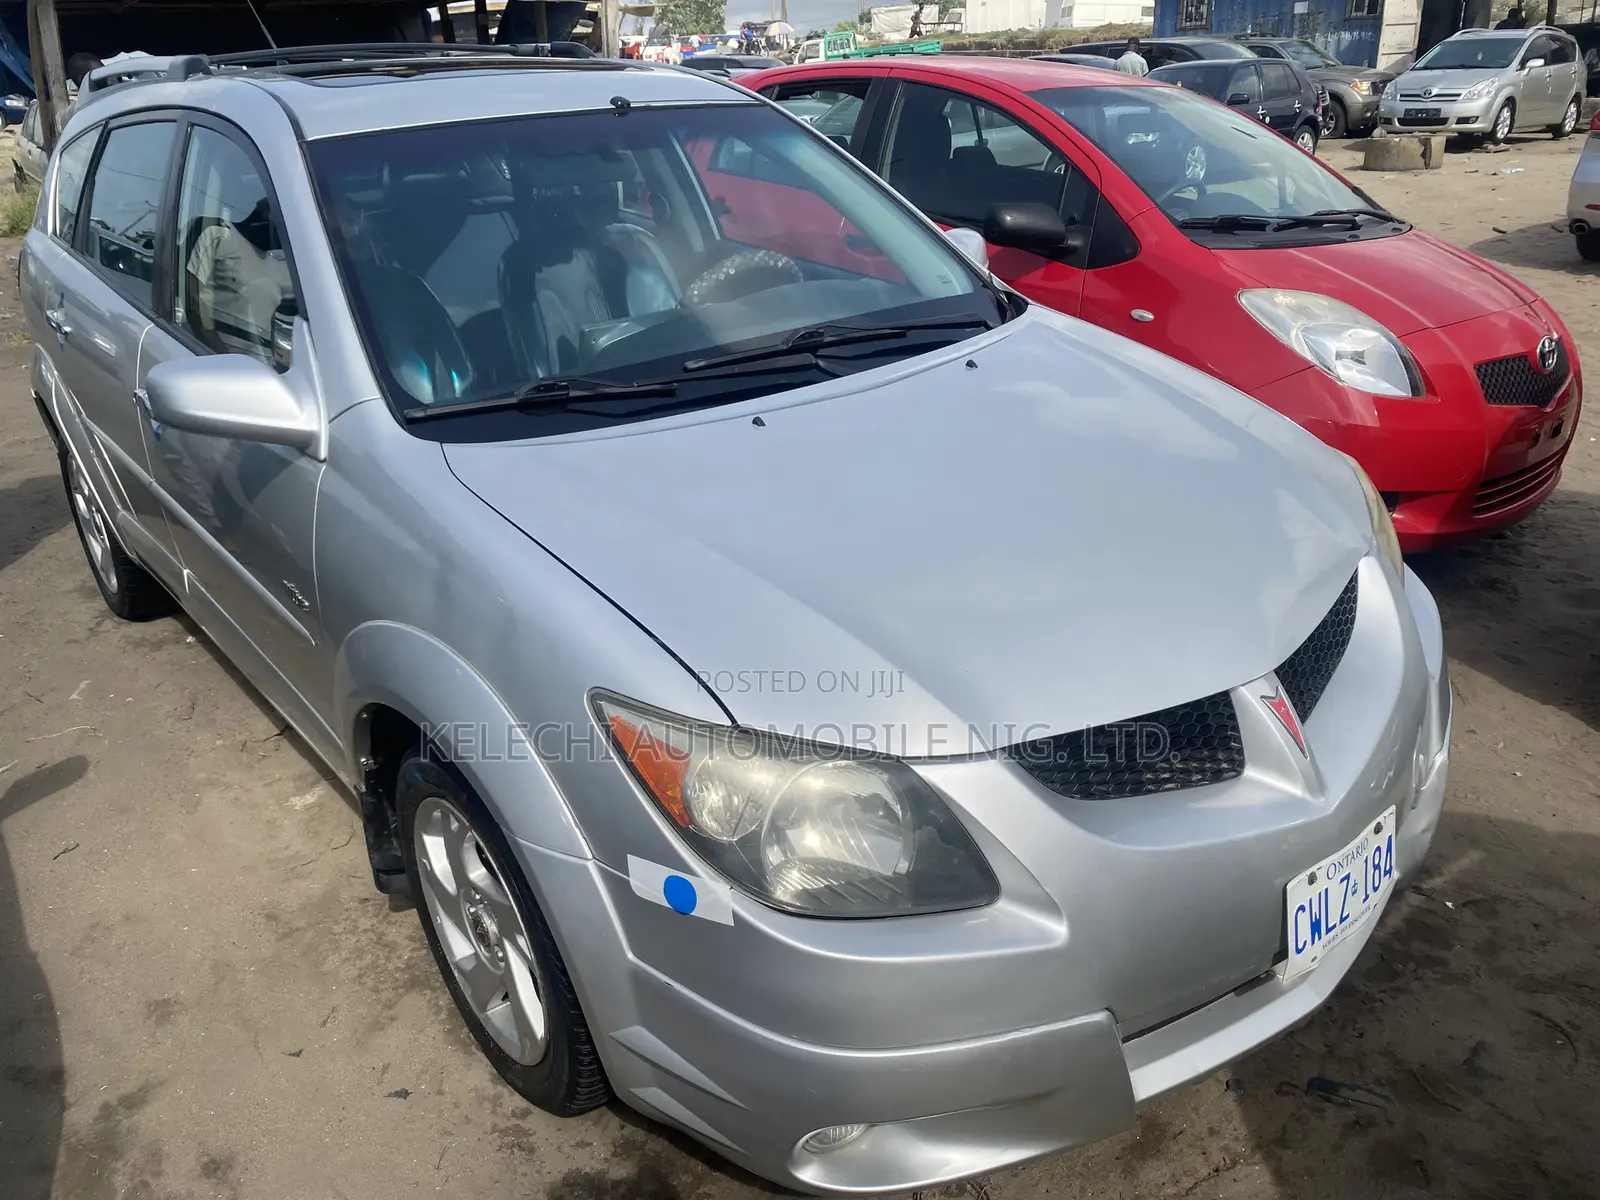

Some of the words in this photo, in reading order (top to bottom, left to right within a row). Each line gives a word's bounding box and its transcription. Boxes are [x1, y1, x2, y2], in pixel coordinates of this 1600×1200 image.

[1294, 871, 1351, 955] CWLZ
[1362, 832, 1393, 905] 184
[1326, 837, 1369, 880] ONTARIO
